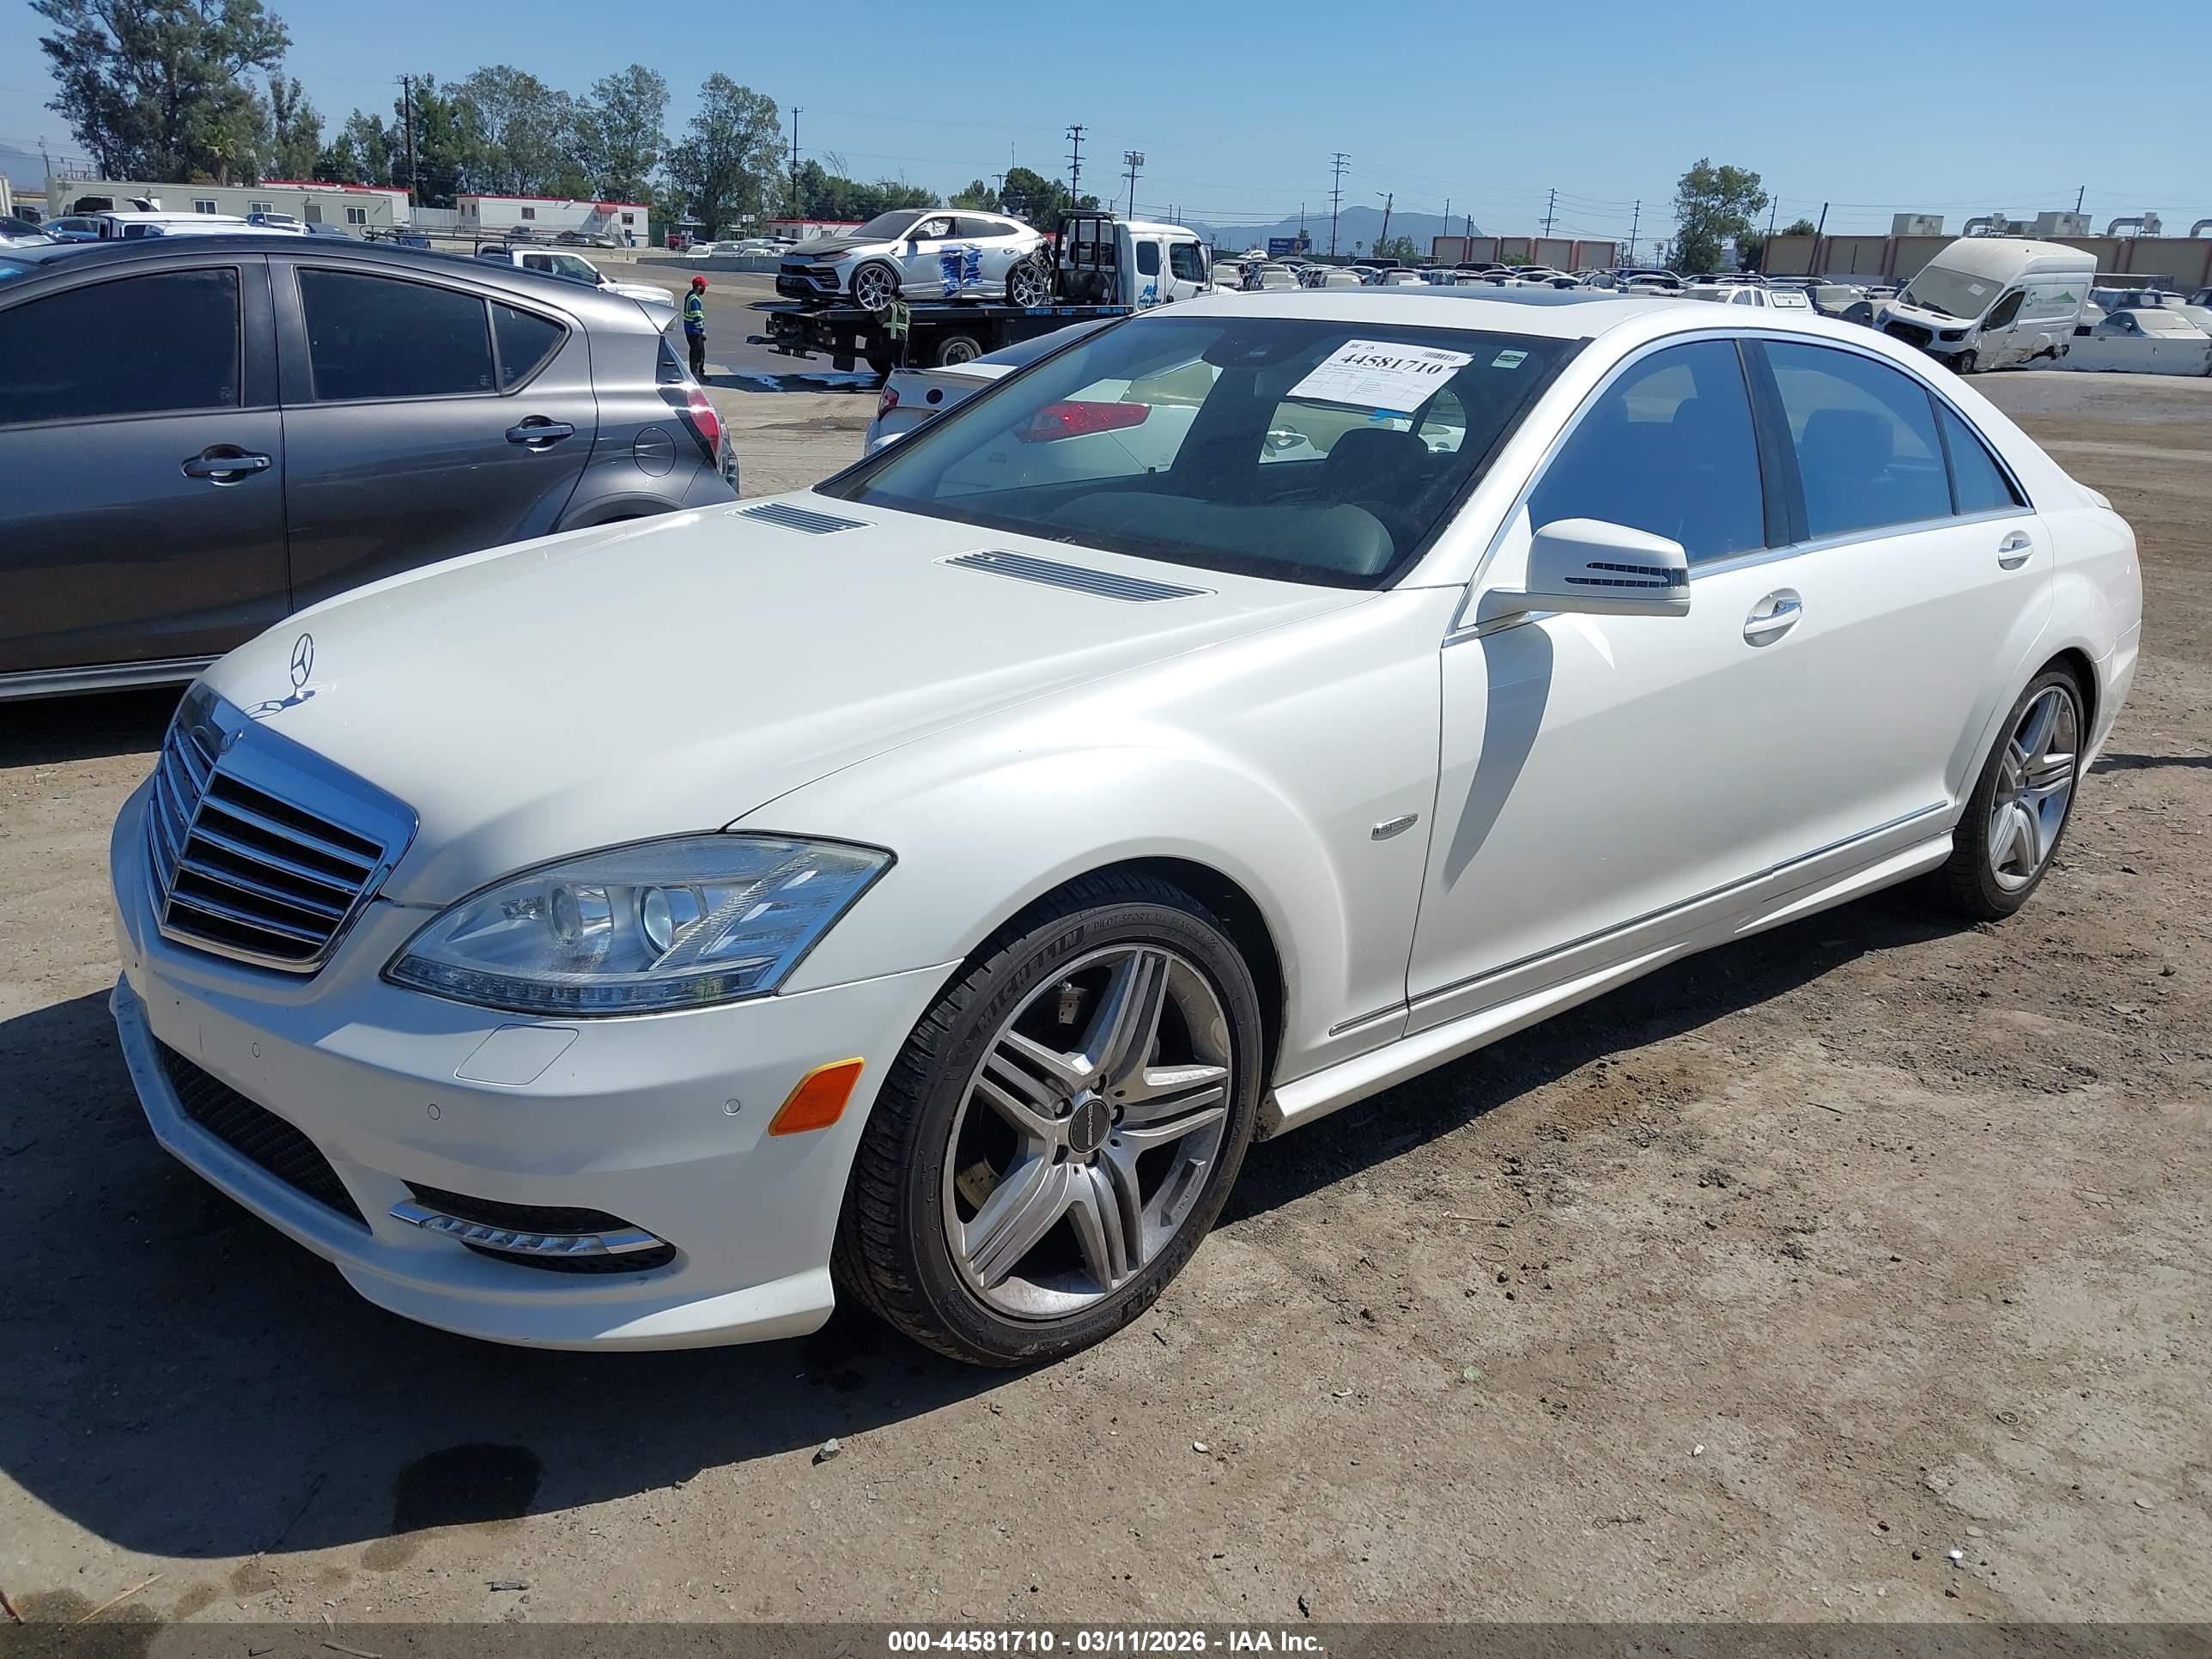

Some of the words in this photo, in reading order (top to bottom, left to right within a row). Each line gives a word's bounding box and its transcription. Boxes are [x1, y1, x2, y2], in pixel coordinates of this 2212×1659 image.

[1340, 353, 1443, 374] 44581710
[1093, 915, 1118, 928] PILOT
[1121, 913, 1151, 923] SPORT
[977, 926, 1085, 1034] MICHELIN
